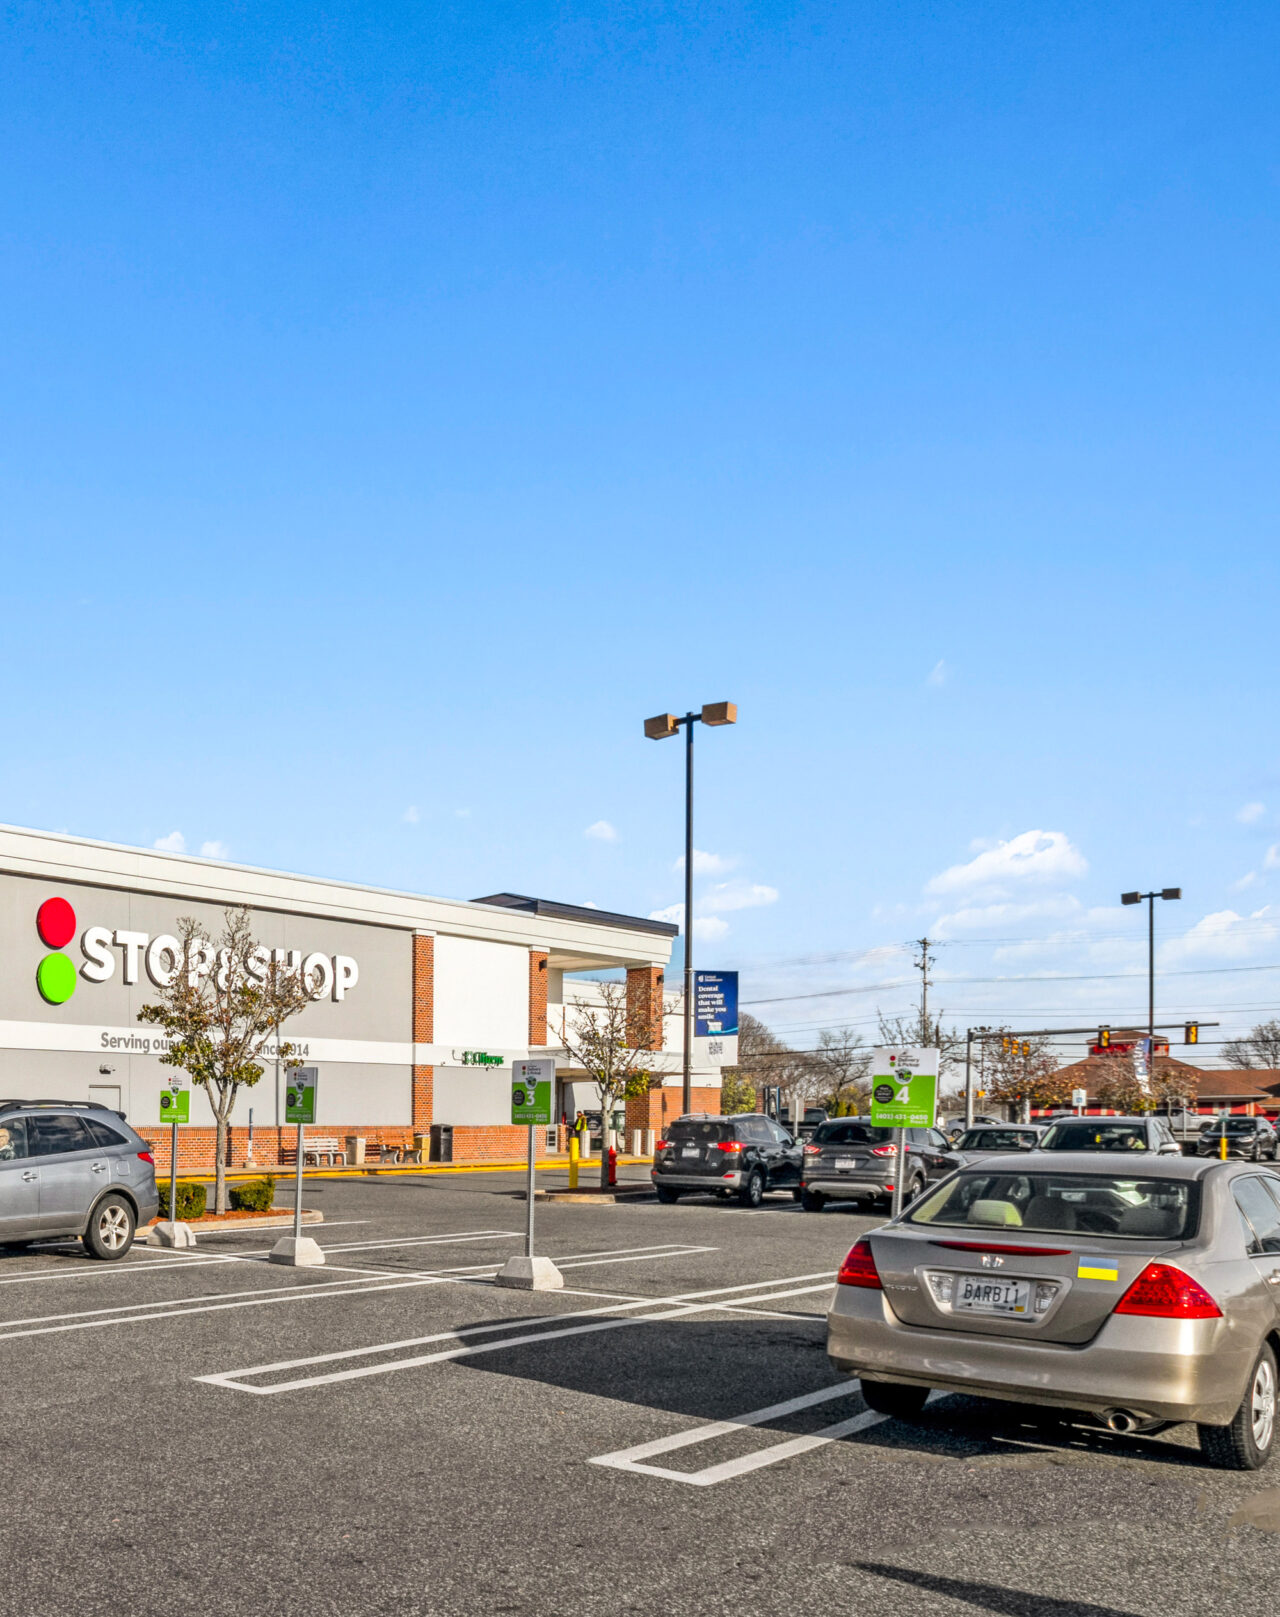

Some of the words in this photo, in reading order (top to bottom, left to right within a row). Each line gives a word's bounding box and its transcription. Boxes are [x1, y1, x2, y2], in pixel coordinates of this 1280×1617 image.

[101, 1032, 150, 1053] Serving
[172, 1097, 178, 1109] 1
[296, 1094, 304, 1107] 2
[526, 1090, 535, 1106] 3
[895, 1086, 910, 1104] 4
